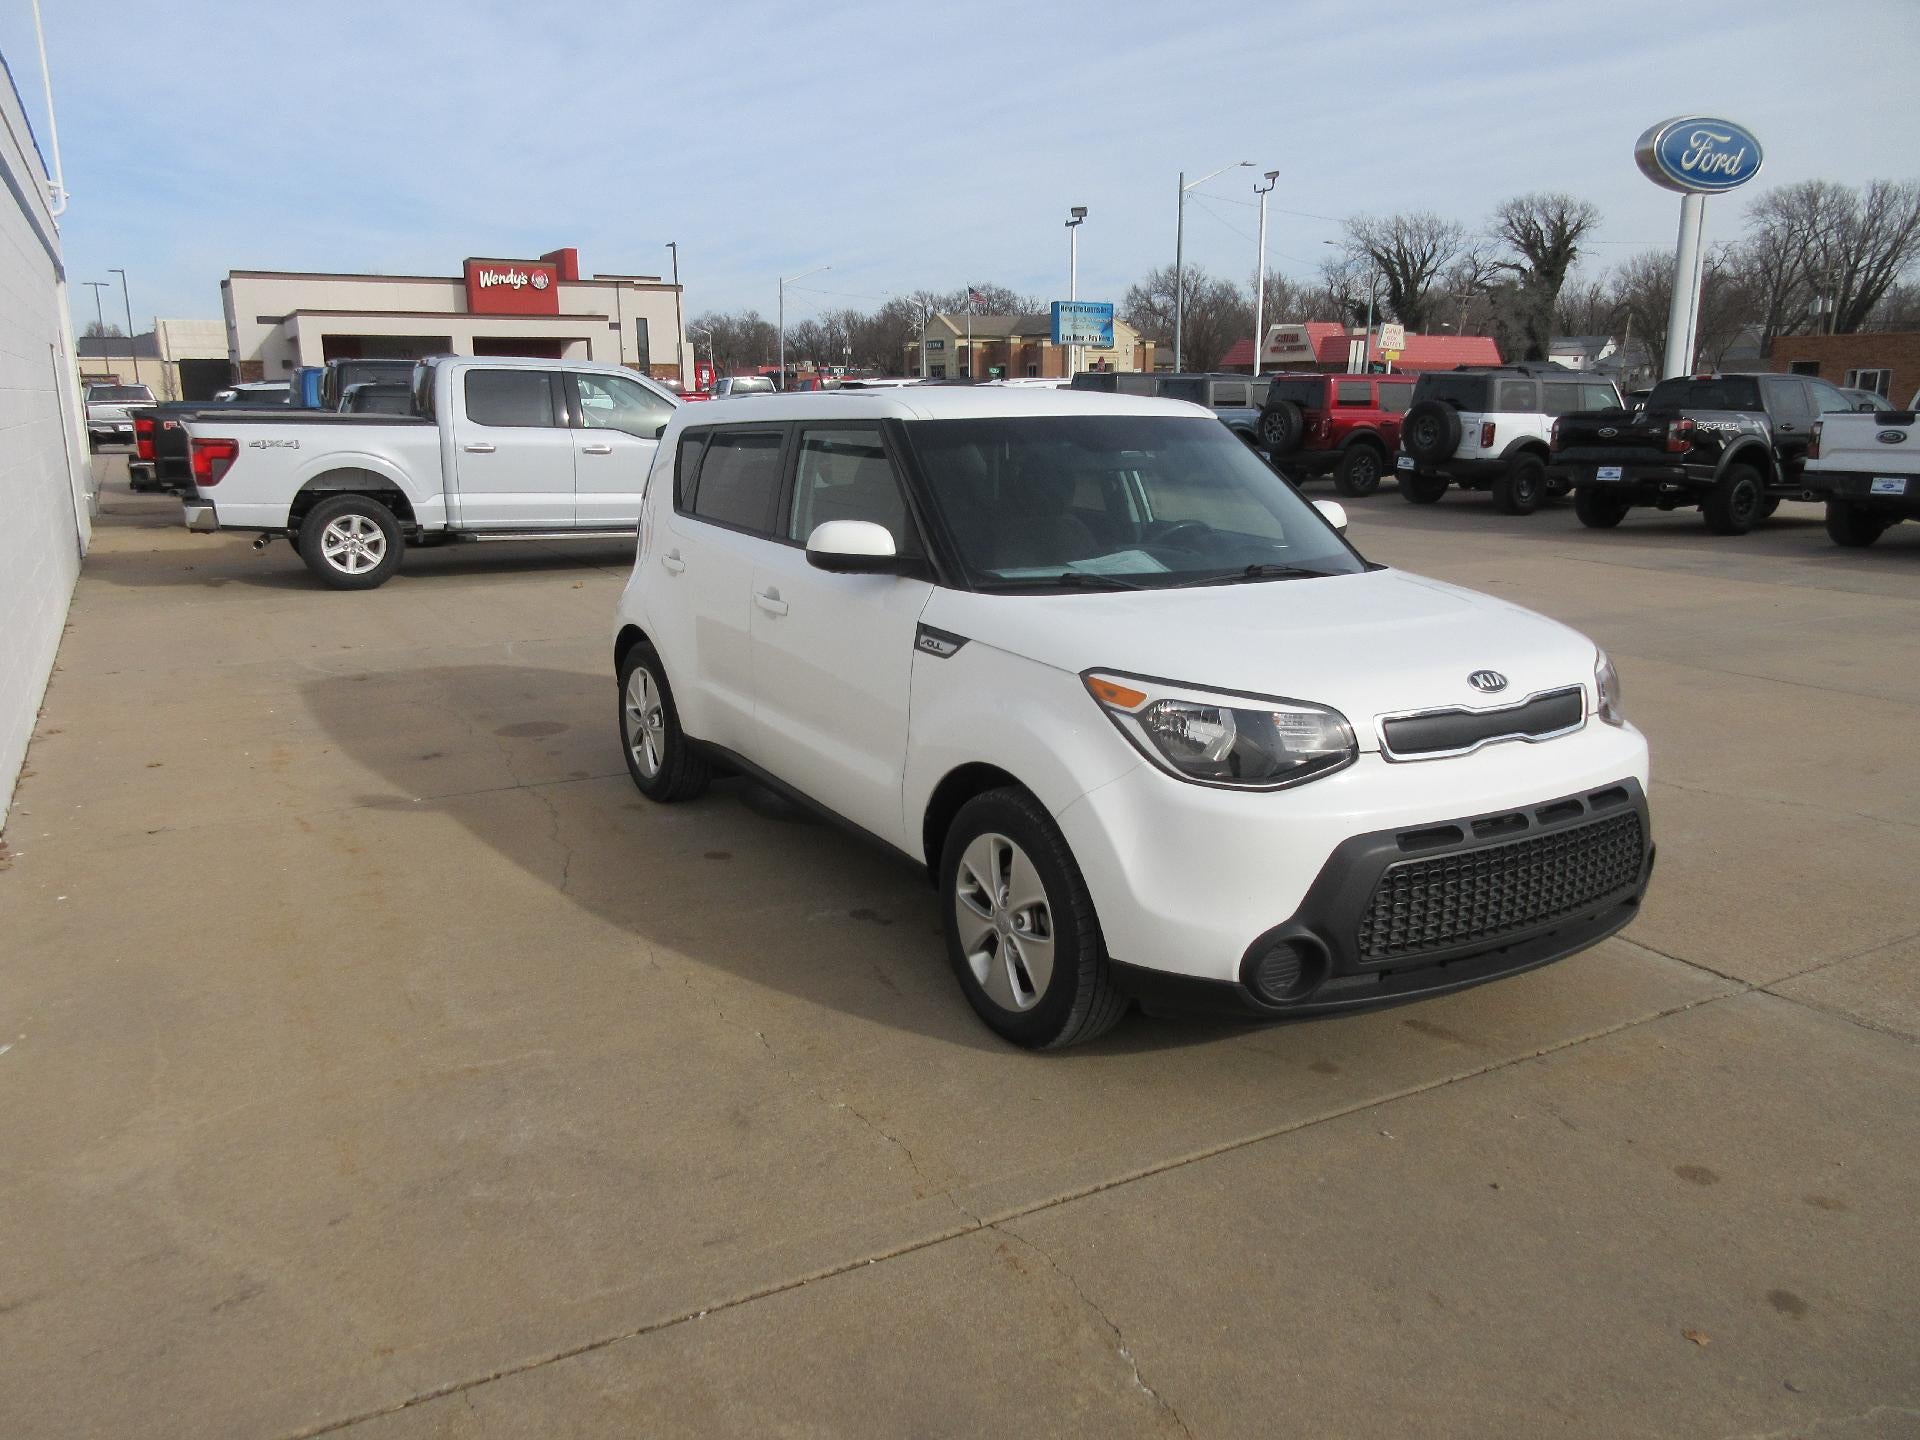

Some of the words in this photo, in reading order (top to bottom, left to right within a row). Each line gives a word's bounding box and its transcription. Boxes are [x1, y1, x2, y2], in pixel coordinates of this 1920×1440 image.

[1680, 130, 1747, 176] Ford
[479, 268, 528, 290] Wendy's
[1696, 421, 1741, 433] RAPTOR
[1472, 672, 1505, 688] KIA
